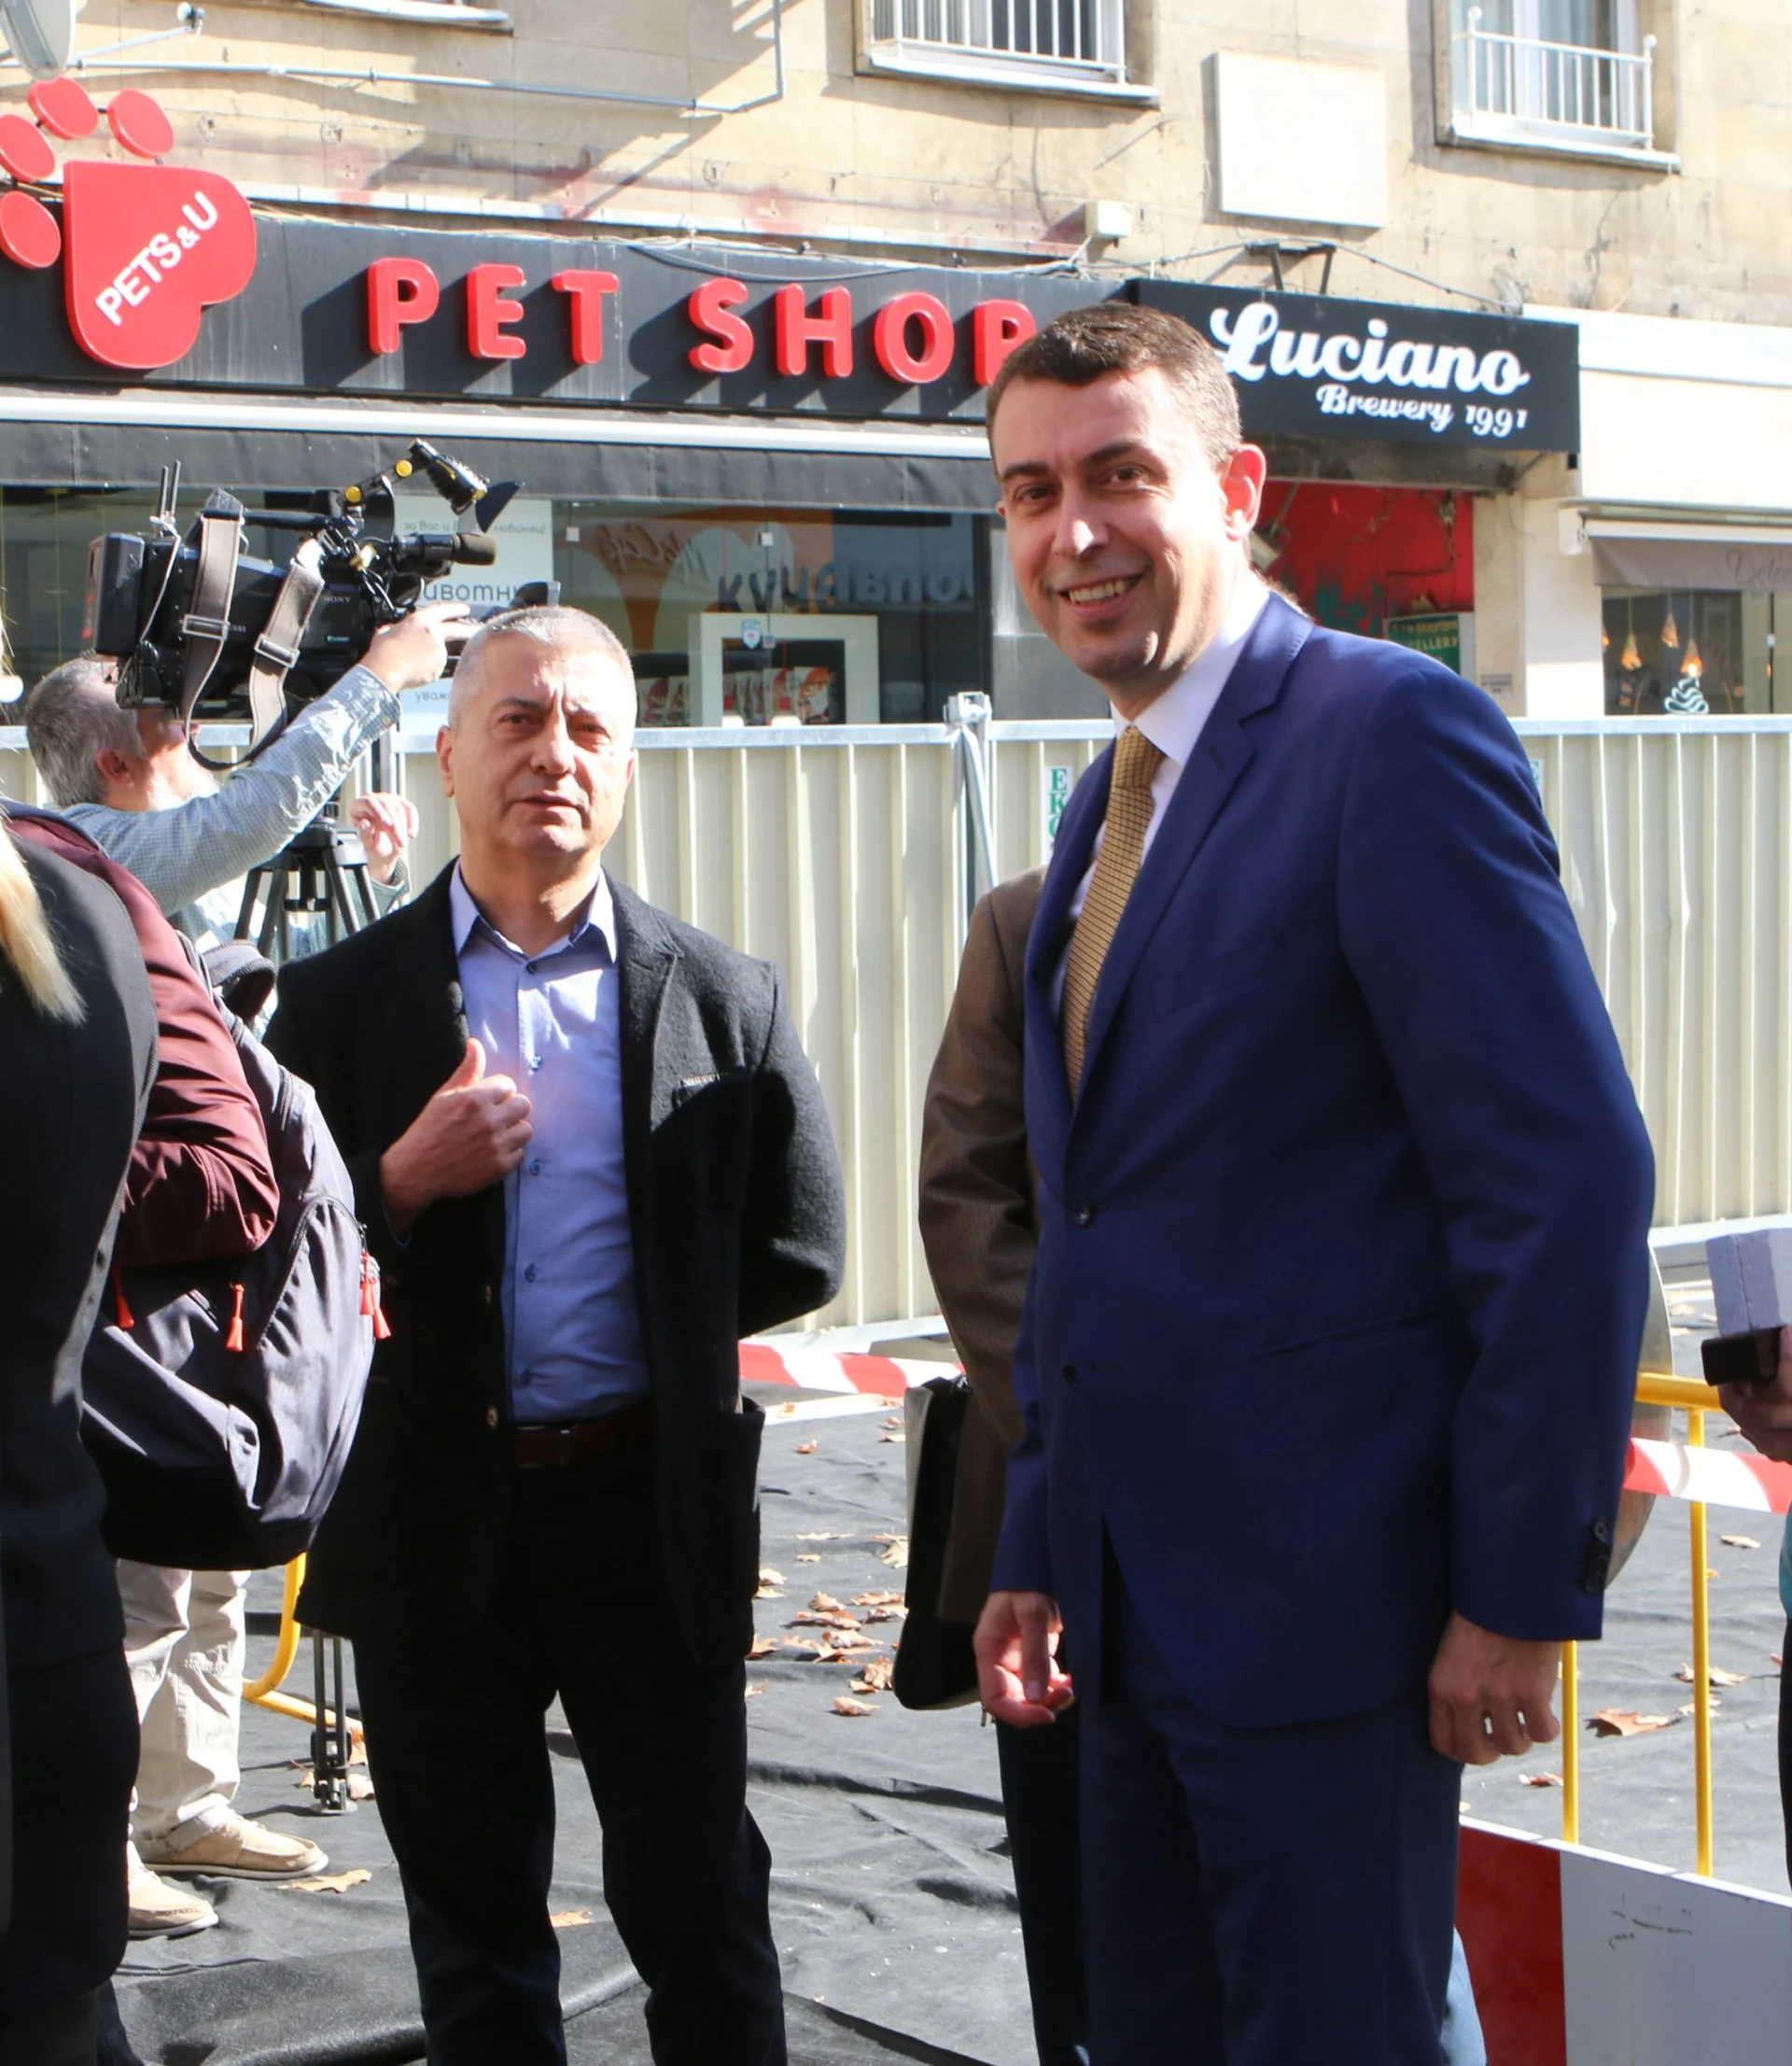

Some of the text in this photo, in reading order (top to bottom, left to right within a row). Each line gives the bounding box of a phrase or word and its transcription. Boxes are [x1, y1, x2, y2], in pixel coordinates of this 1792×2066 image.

[368, 257, 1037, 386] PET SHOP
[1209, 302, 1531, 395] Luciano
[1316, 384, 1528, 439] Brewery 1991
